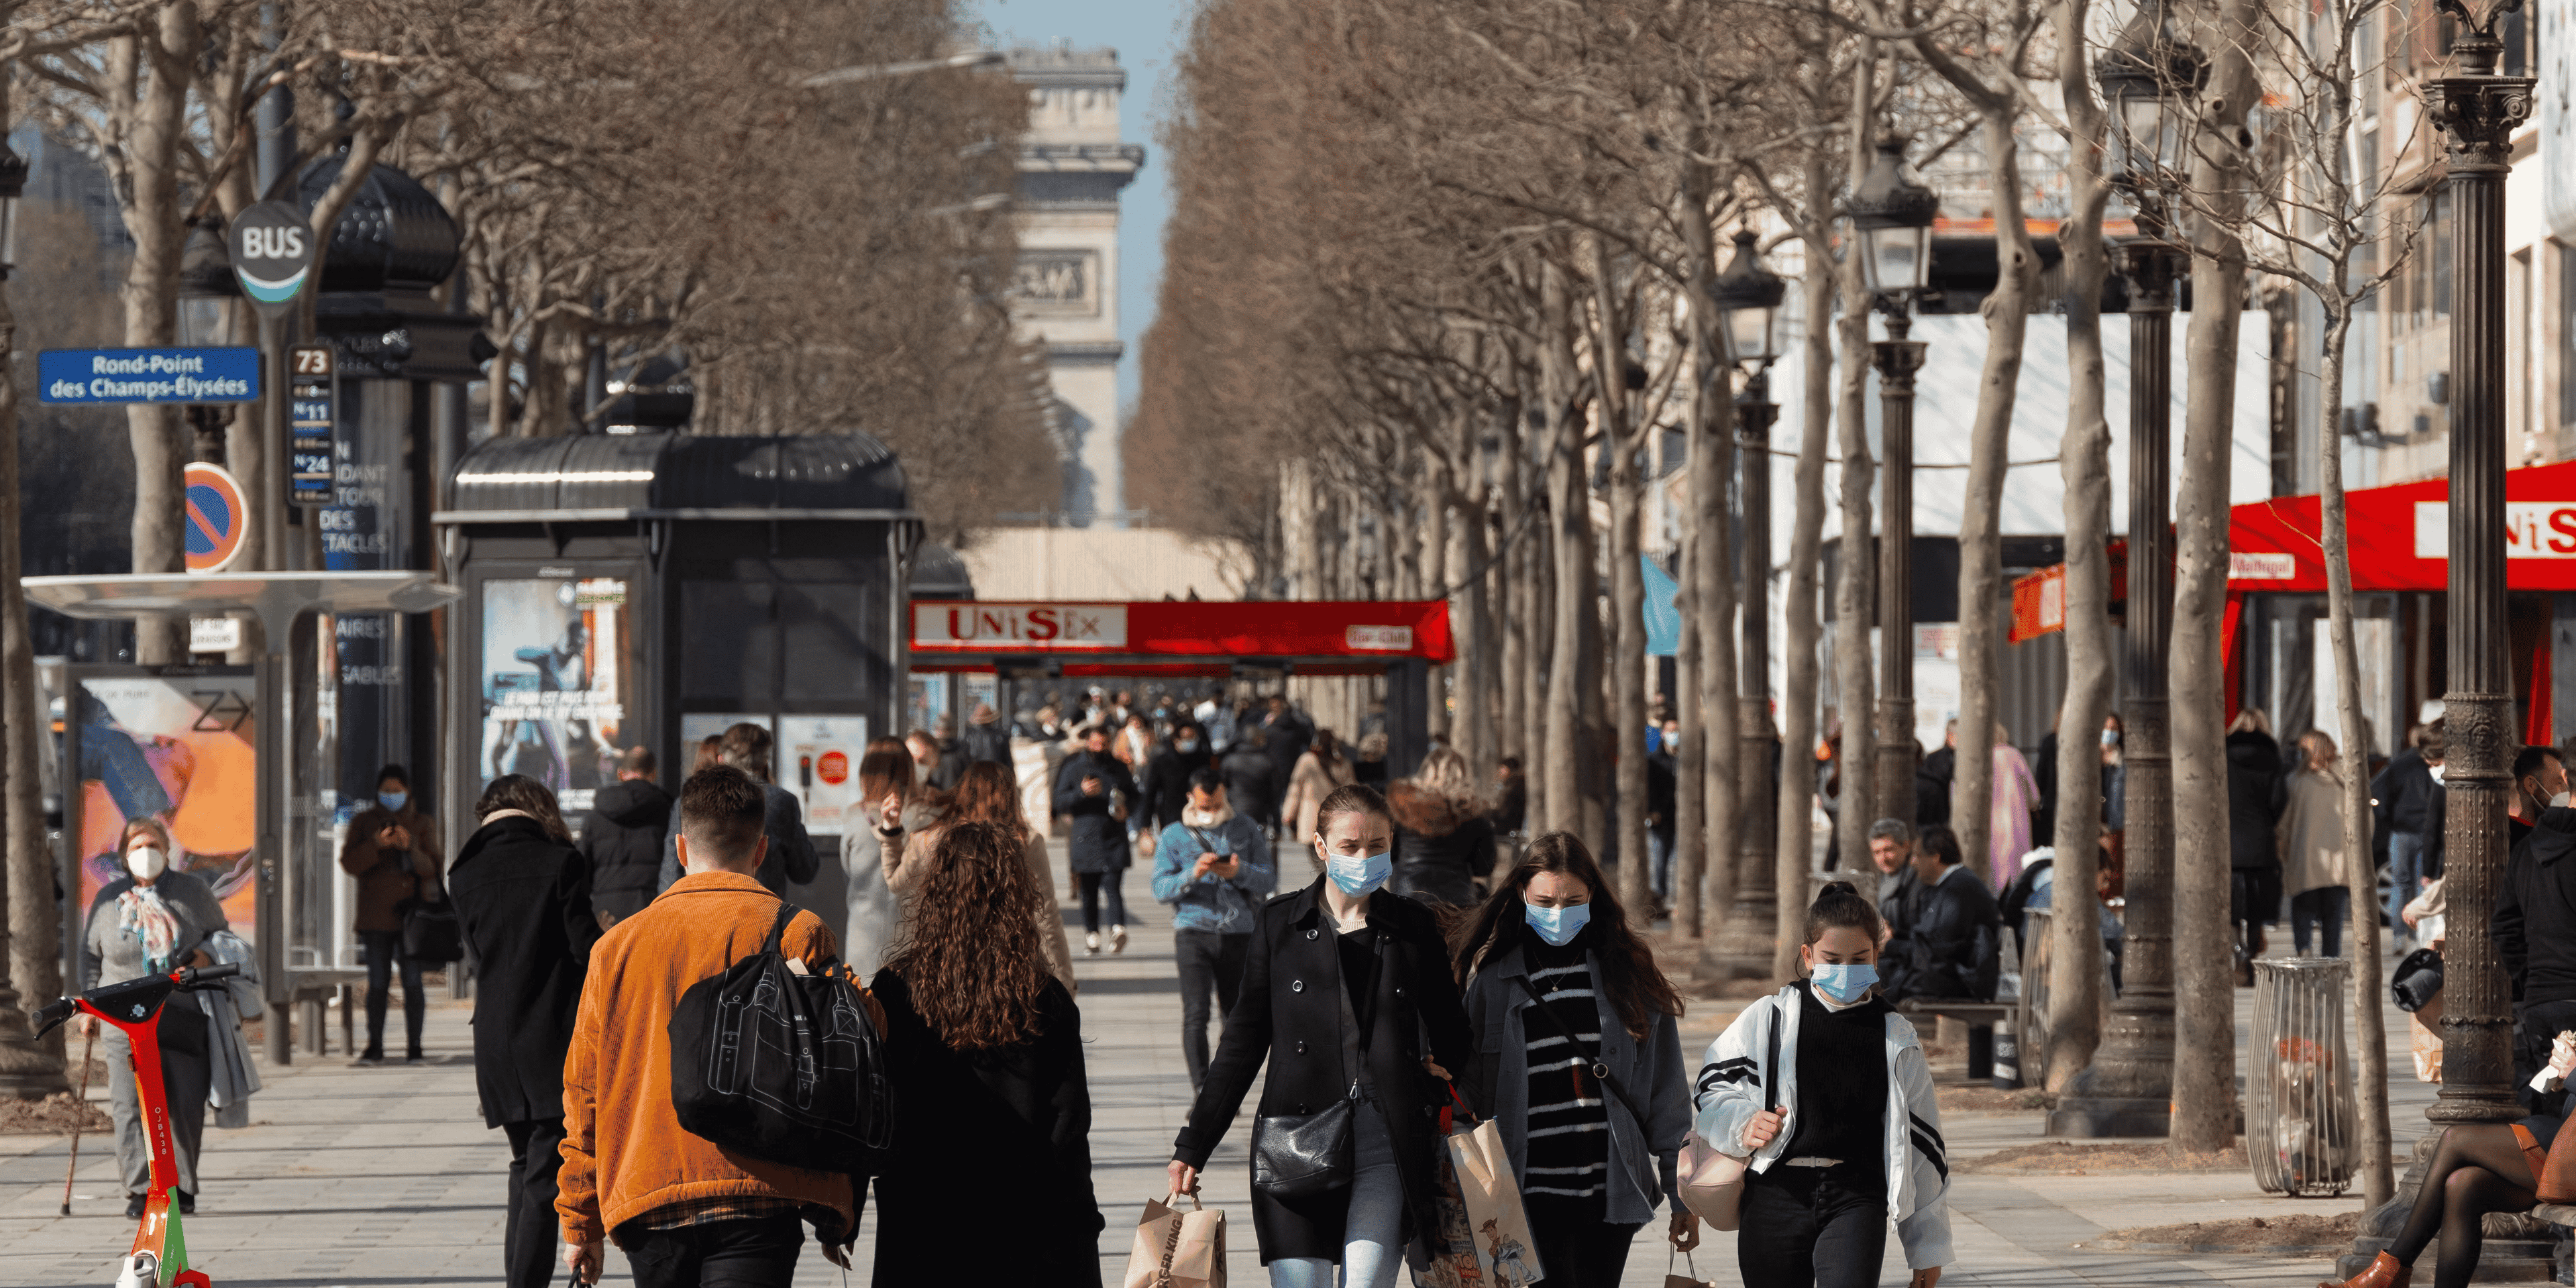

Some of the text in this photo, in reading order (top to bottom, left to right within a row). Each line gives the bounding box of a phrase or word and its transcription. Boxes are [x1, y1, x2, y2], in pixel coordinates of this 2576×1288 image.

[243, 226, 305, 259] BUS
[93, 354, 204, 374] Rond-Point
[296, 350, 327, 373] 73
[50, 372, 248, 400] des Champs-Élysées
[319, 510, 356, 531] DES
[2506, 508, 2576, 554] NiS
[1165, 1218, 1183, 1252] KING
[1454, 1252, 1477, 1269] TOY
